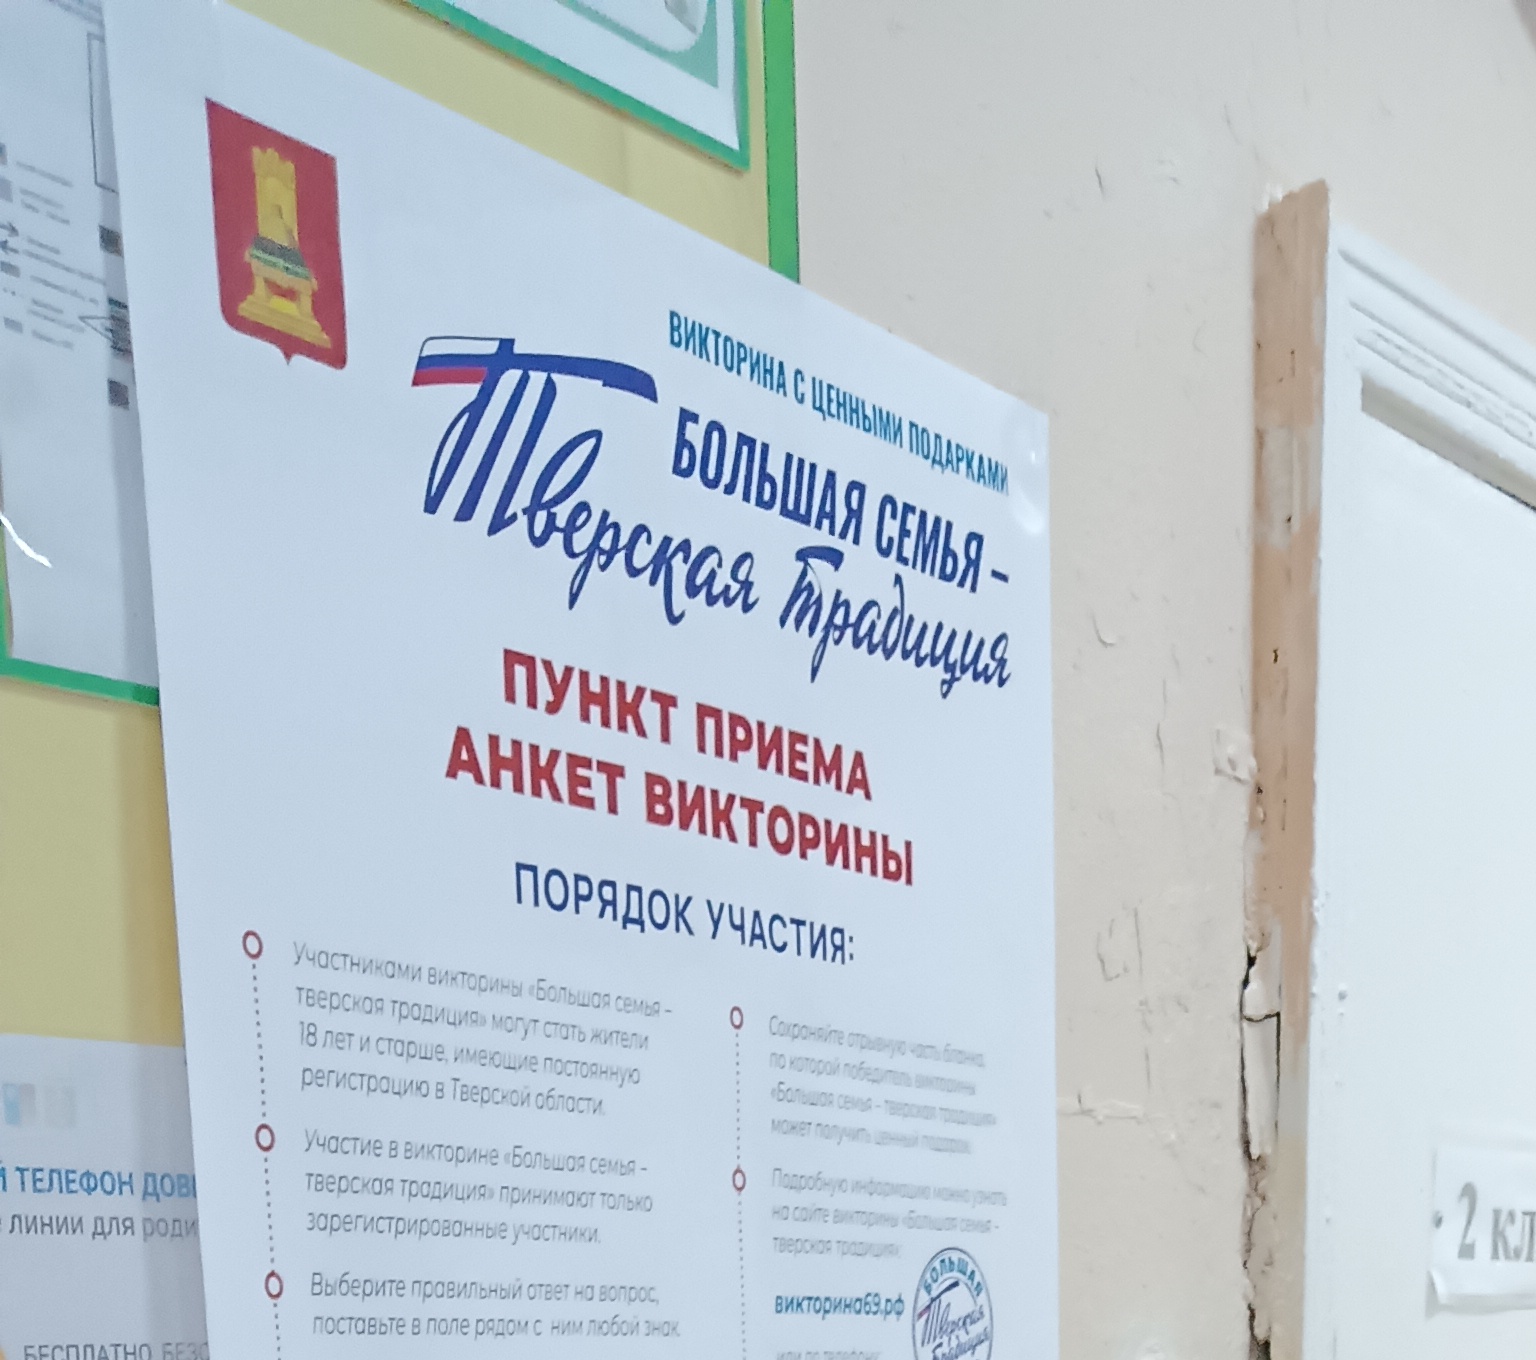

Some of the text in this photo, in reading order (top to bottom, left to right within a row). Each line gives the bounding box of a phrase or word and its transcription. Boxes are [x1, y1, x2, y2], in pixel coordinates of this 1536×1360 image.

[669, 310, 1009, 495] ВИКТОРИНА С ЦЕННЫМИ ПОДАРКАМИ
[411, 336, 1011, 699] Тверская традиция
[672, 407, 985, 592] БОЛЬШАЯ СЕМЬЯ
[503, 649, 873, 799] ПУНКТ ПРИЕМА
[445, 726, 913, 886] АНКЕТ ВИКТОРИНЫ
[514, 862, 854, 963] ПОРЯДОК УЧАСТИЯ:
[293, 941, 611, 1009] Участниками викторины «Большая
[295, 985, 587, 1043] тверская традиция» могут стать
[299, 1020, 641, 1087] 18 лет старше, имеющие постоянную
[300, 1066, 603, 1114] регистрацию Тверской области.
[304, 1128, 586, 1172] Участие викторине «Большая
[15, 1166, 134, 1196] ТЕЛЕФОН
[305, 1171, 597, 1208] тверская традиция» принимают
[306, 1211, 601, 1245] зарегистрированные участники.
[1457, 1181, 1478, 1261] 2
[310, 1270, 660, 1305] Выберите правильный ответ вопрос,
[774, 1291, 905, 1320] викторина69.рф
[923, 1256, 985, 1299] БОЛЬШАЯ
[313, 1313, 640, 1339] поставьте поле рядом любой
